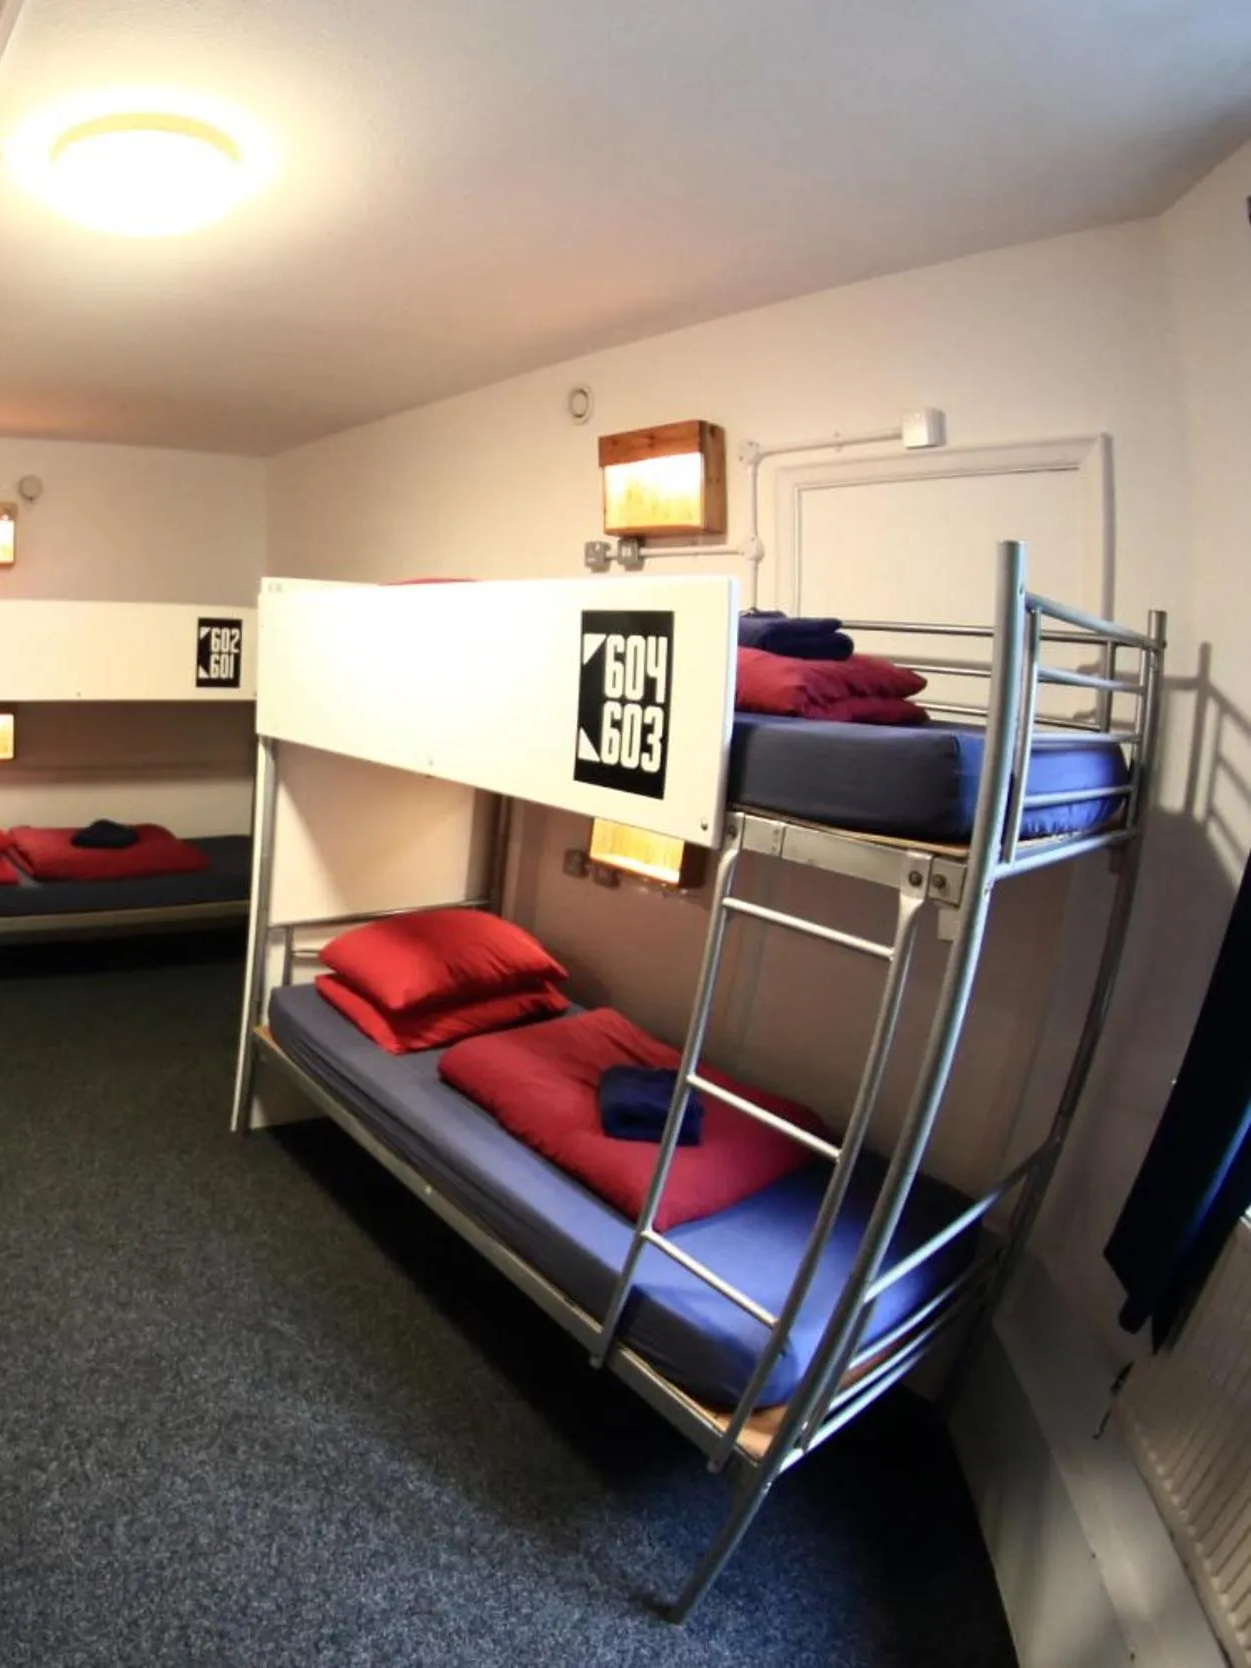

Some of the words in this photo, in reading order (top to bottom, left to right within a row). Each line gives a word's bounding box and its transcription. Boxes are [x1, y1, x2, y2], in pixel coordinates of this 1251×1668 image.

[211, 627, 240, 653] 602
[210, 653, 235, 679] 601
[604, 633, 668, 704] 604
[600, 700, 664, 773] 603
